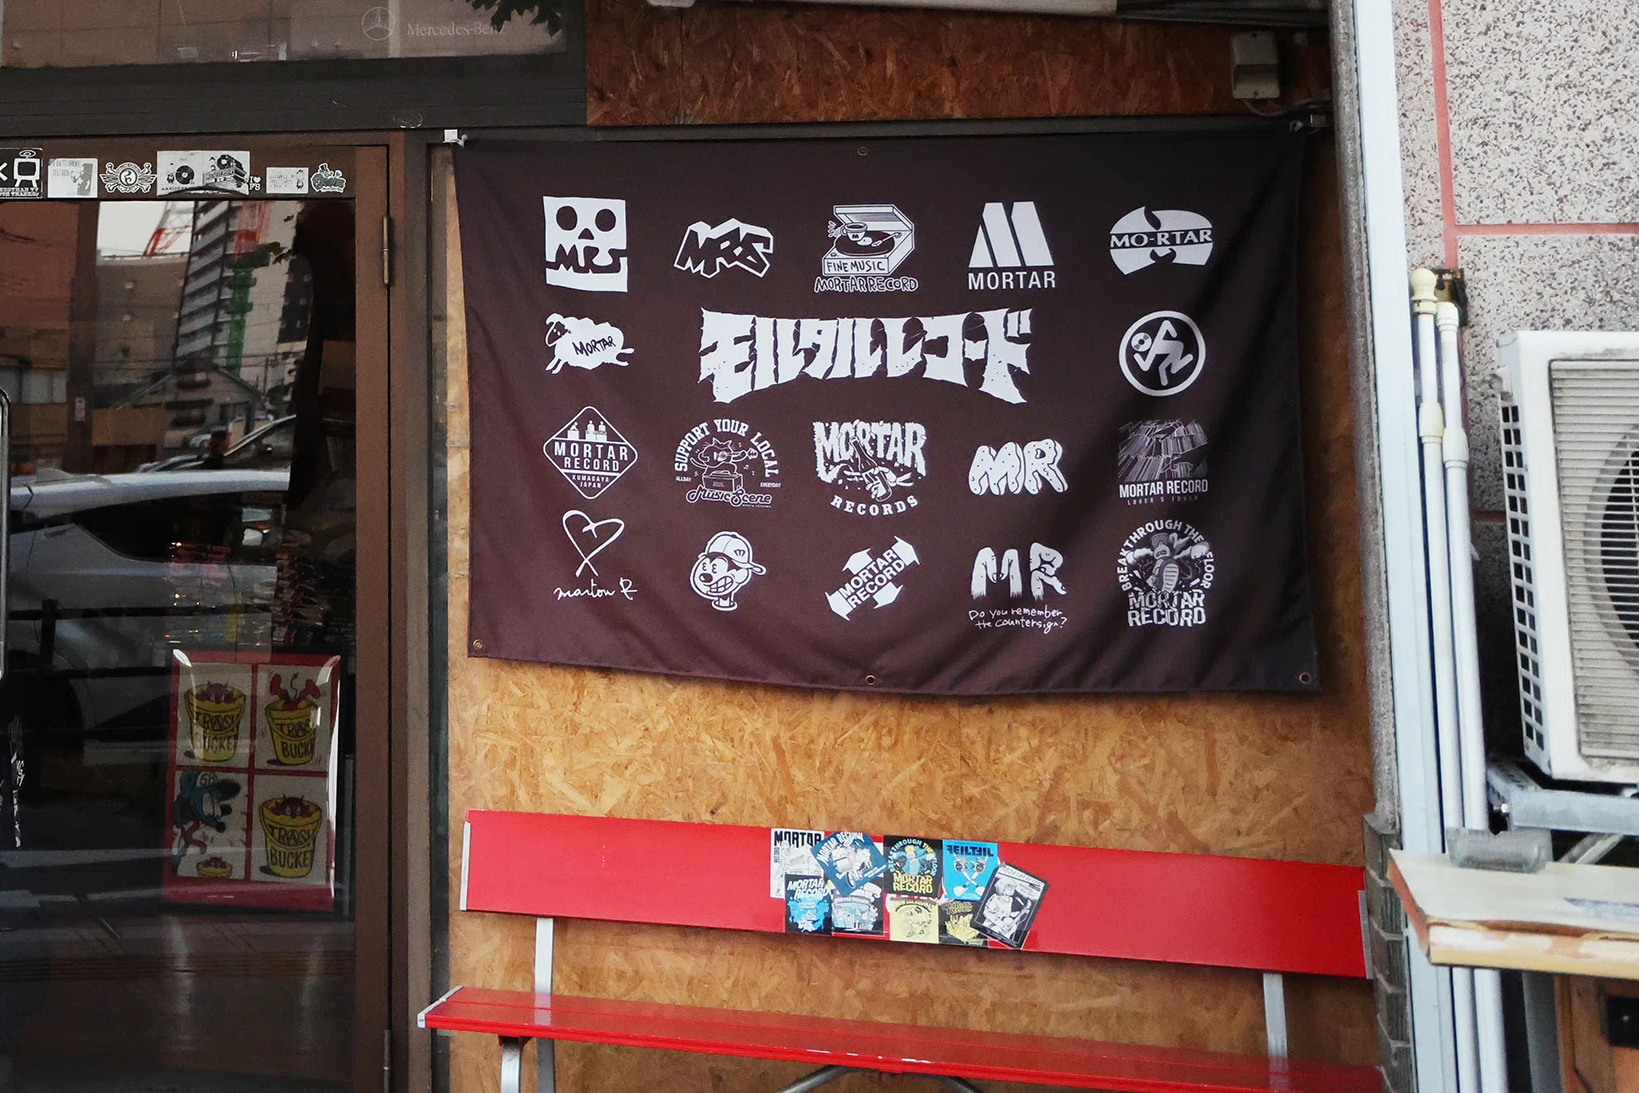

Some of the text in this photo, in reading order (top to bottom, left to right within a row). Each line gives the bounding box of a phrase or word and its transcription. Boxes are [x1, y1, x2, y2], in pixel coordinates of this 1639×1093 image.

[407, 21, 502, 37] Mercedes-Ben
[1110, 228, 1213, 248] MO-RTAR
[826, 260, 886, 272] FINE MUSIC
[814, 275, 918, 293] MORTAR RECORD
[968, 271, 1056, 290] MORTAR
[572, 335, 616, 357] MORTAR
[554, 441, 629, 461] MORTAR
[674, 418, 779, 478] SUPPORT YOUR LOCAL
[813, 420, 928, 483] MORTAR
[564, 457, 620, 472] RECORD
[968, 439, 1068, 495] MR
[572, 474, 610, 483] KUMAGAYA
[686, 484, 772, 507] Music Scene
[1119, 479, 1209, 498] MORTAR RECORD
[830, 494, 918, 516] RECORDS
[1117, 519, 1215, 591] BREAK THROUGH THE FLOOR
[839, 549, 898, 599] MORTAR
[847, 558, 905, 609] RECORD
[1129, 591, 1205, 610] MORTAR
[969, 605, 1063, 621] Do you remember
[1127, 607, 1207, 627] RECORD
[975, 619, 992, 629] the
[774, 830, 822, 847] MORTAR
[892, 881, 933, 894] RECORD
[893, 871, 933, 885] MORTAR
